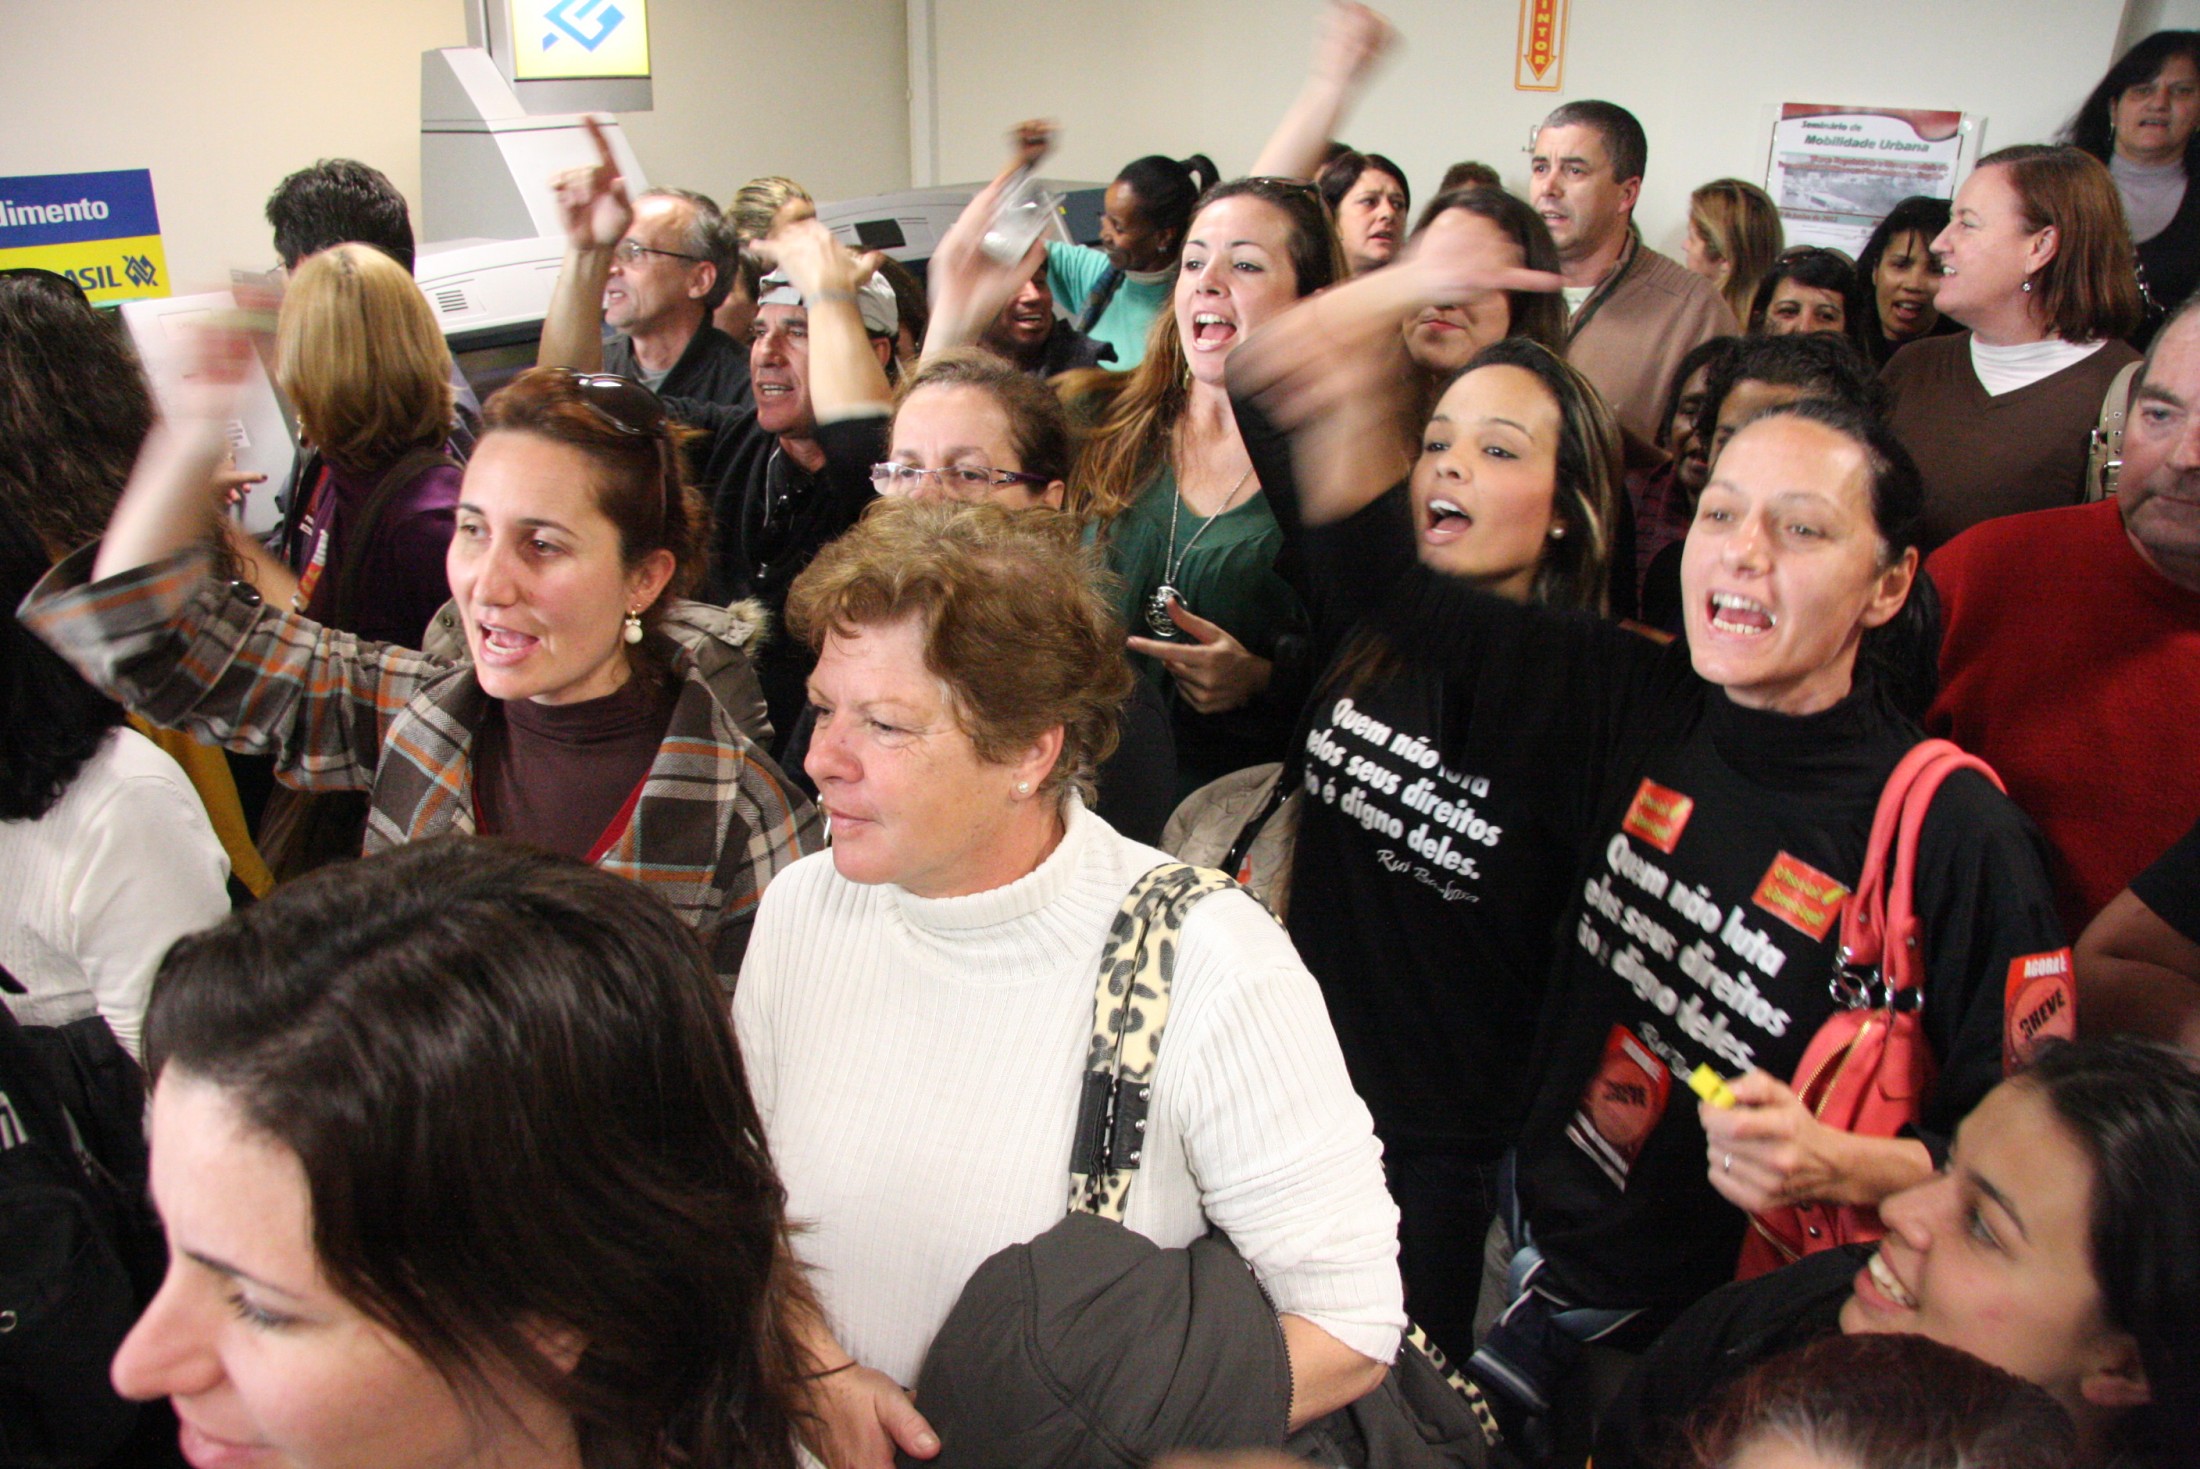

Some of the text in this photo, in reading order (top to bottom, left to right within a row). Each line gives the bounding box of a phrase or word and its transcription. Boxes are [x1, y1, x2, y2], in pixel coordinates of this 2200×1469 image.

[1804, 135, 1930, 153] Mobilidade Urbana
[1332, 698, 1392, 746] Quem
[1388, 733, 1439, 769] não
[1322, 777, 1337, 805] é
[1340, 786, 1404, 839] digno
[1407, 823, 1480, 880] deles.
[1345, 755, 1402, 795] seus
[1402, 777, 1503, 847] direitos
[1607, 833, 1669, 900] Quem
[1668, 880, 1722, 933] não
[1720, 905, 1787, 978] luta
[1611, 942, 1679, 1016] digno
[1678, 939, 1792, 1038] direitos
